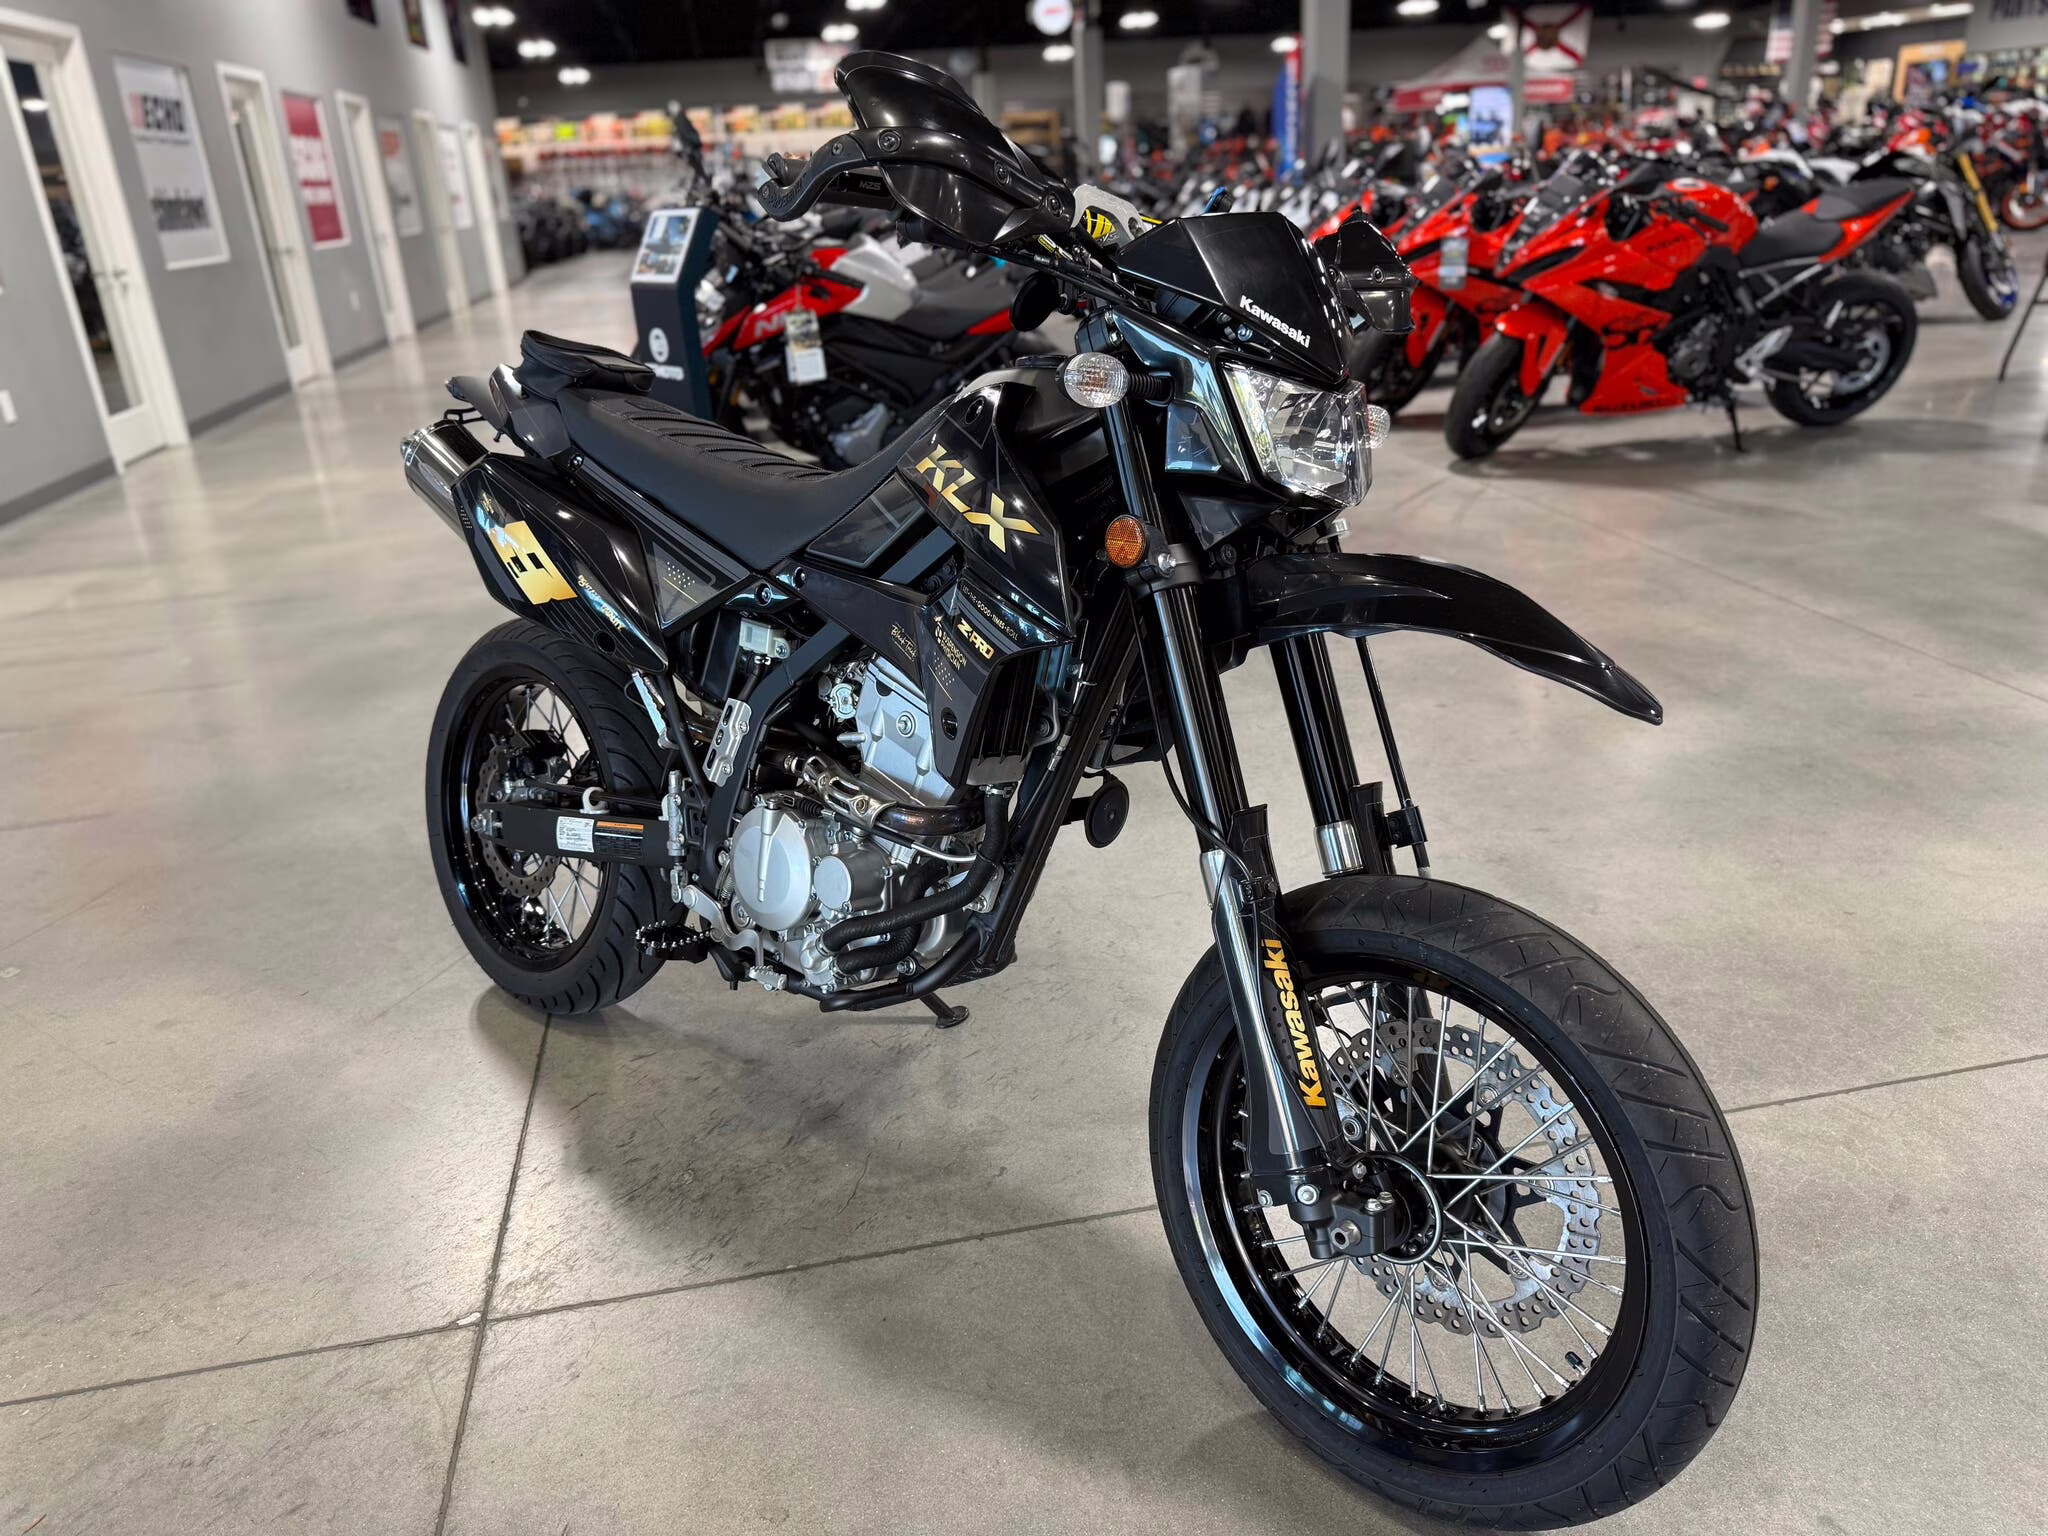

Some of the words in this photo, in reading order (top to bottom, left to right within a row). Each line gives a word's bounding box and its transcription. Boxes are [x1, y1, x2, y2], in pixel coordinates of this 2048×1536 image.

[1240, 294, 1311, 348] Kawasaki
[915, 443, 1040, 553] KLX
[1261, 938, 1328, 1108] Kawasaki
